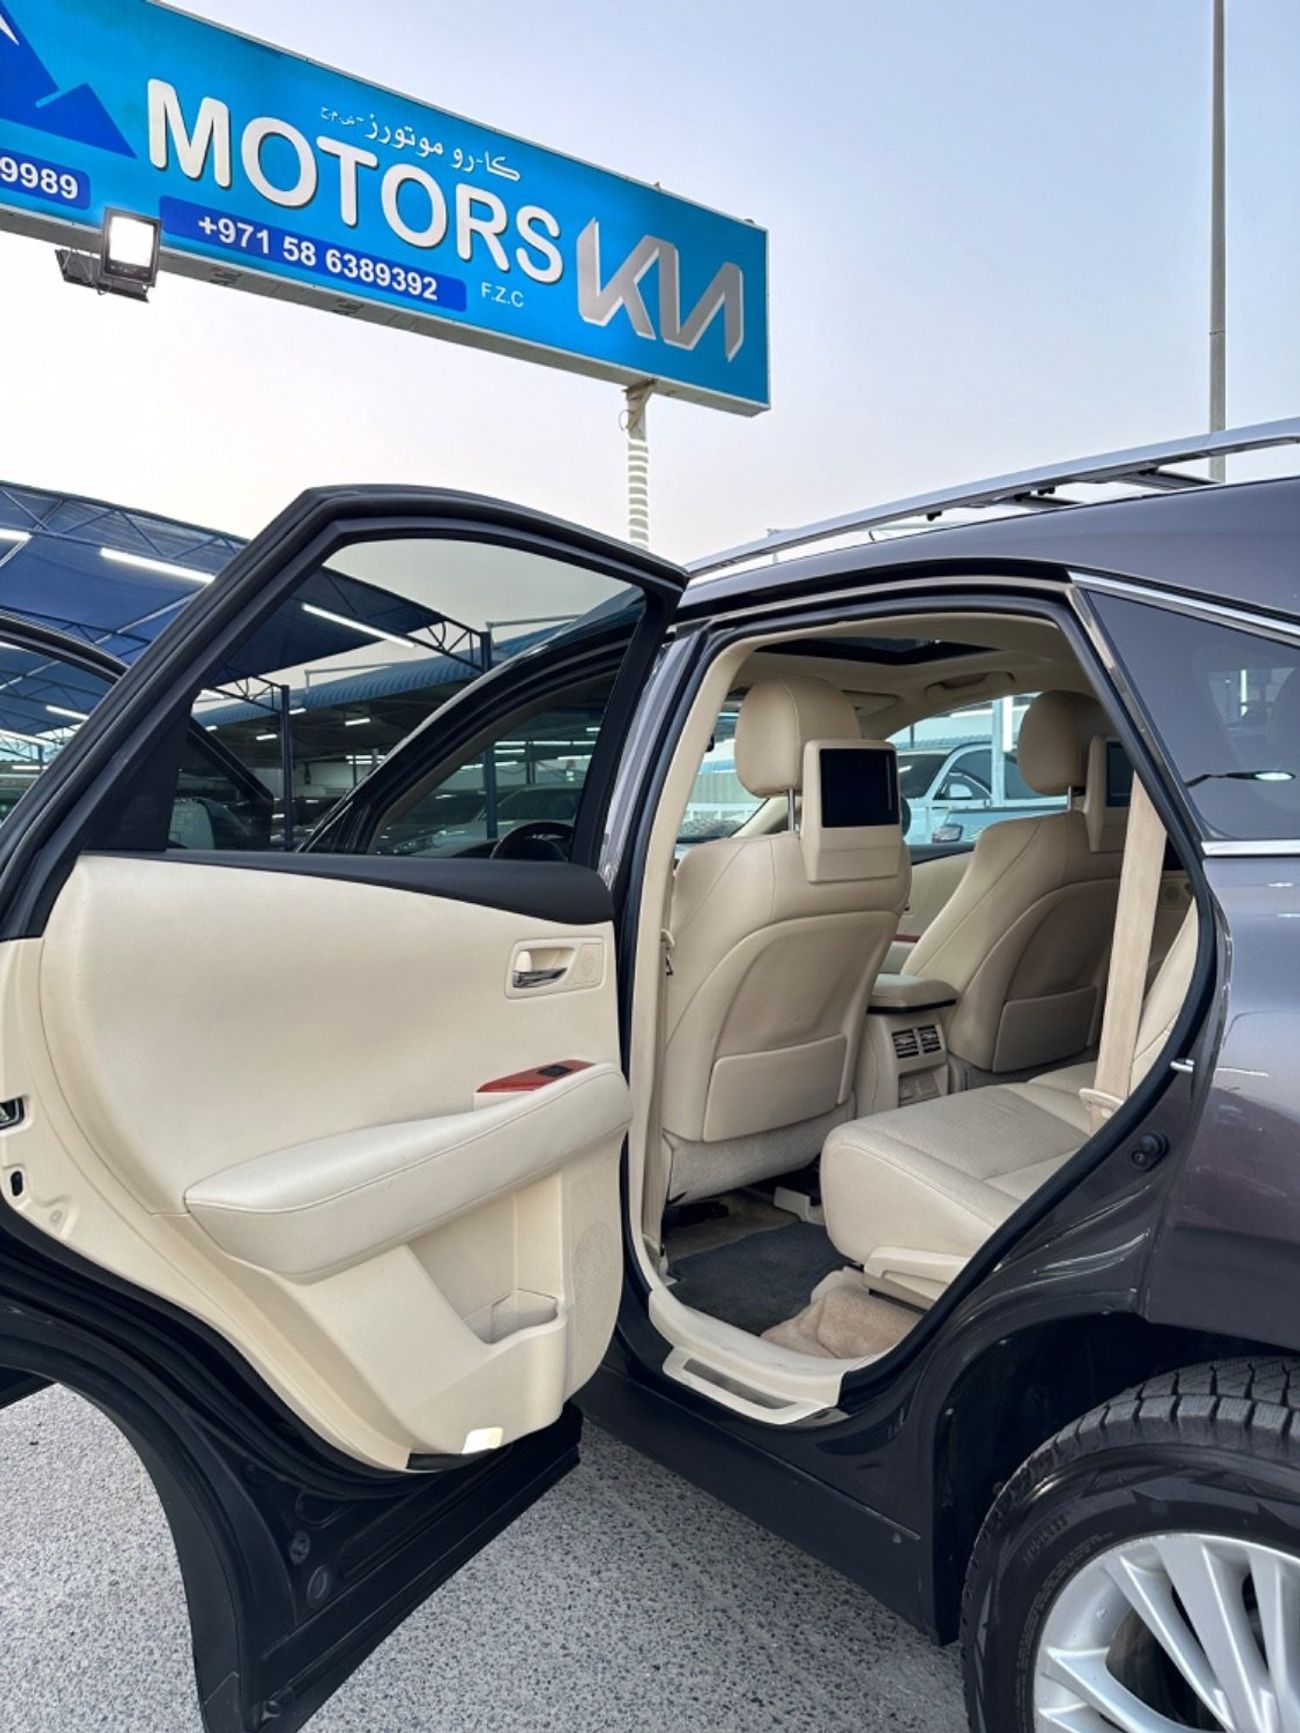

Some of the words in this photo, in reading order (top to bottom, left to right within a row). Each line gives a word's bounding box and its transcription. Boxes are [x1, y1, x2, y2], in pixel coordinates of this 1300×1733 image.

[364, 113, 444, 157] موتورز
[0, 156, 78, 199] 9989
[147, 78, 564, 284] MOTORS
[198, 216, 270, 254] +971
[283, 237, 317, 267] 58
[325, 249, 438, 301] 6389392
[480, 281, 525, 308] F.Z.C
